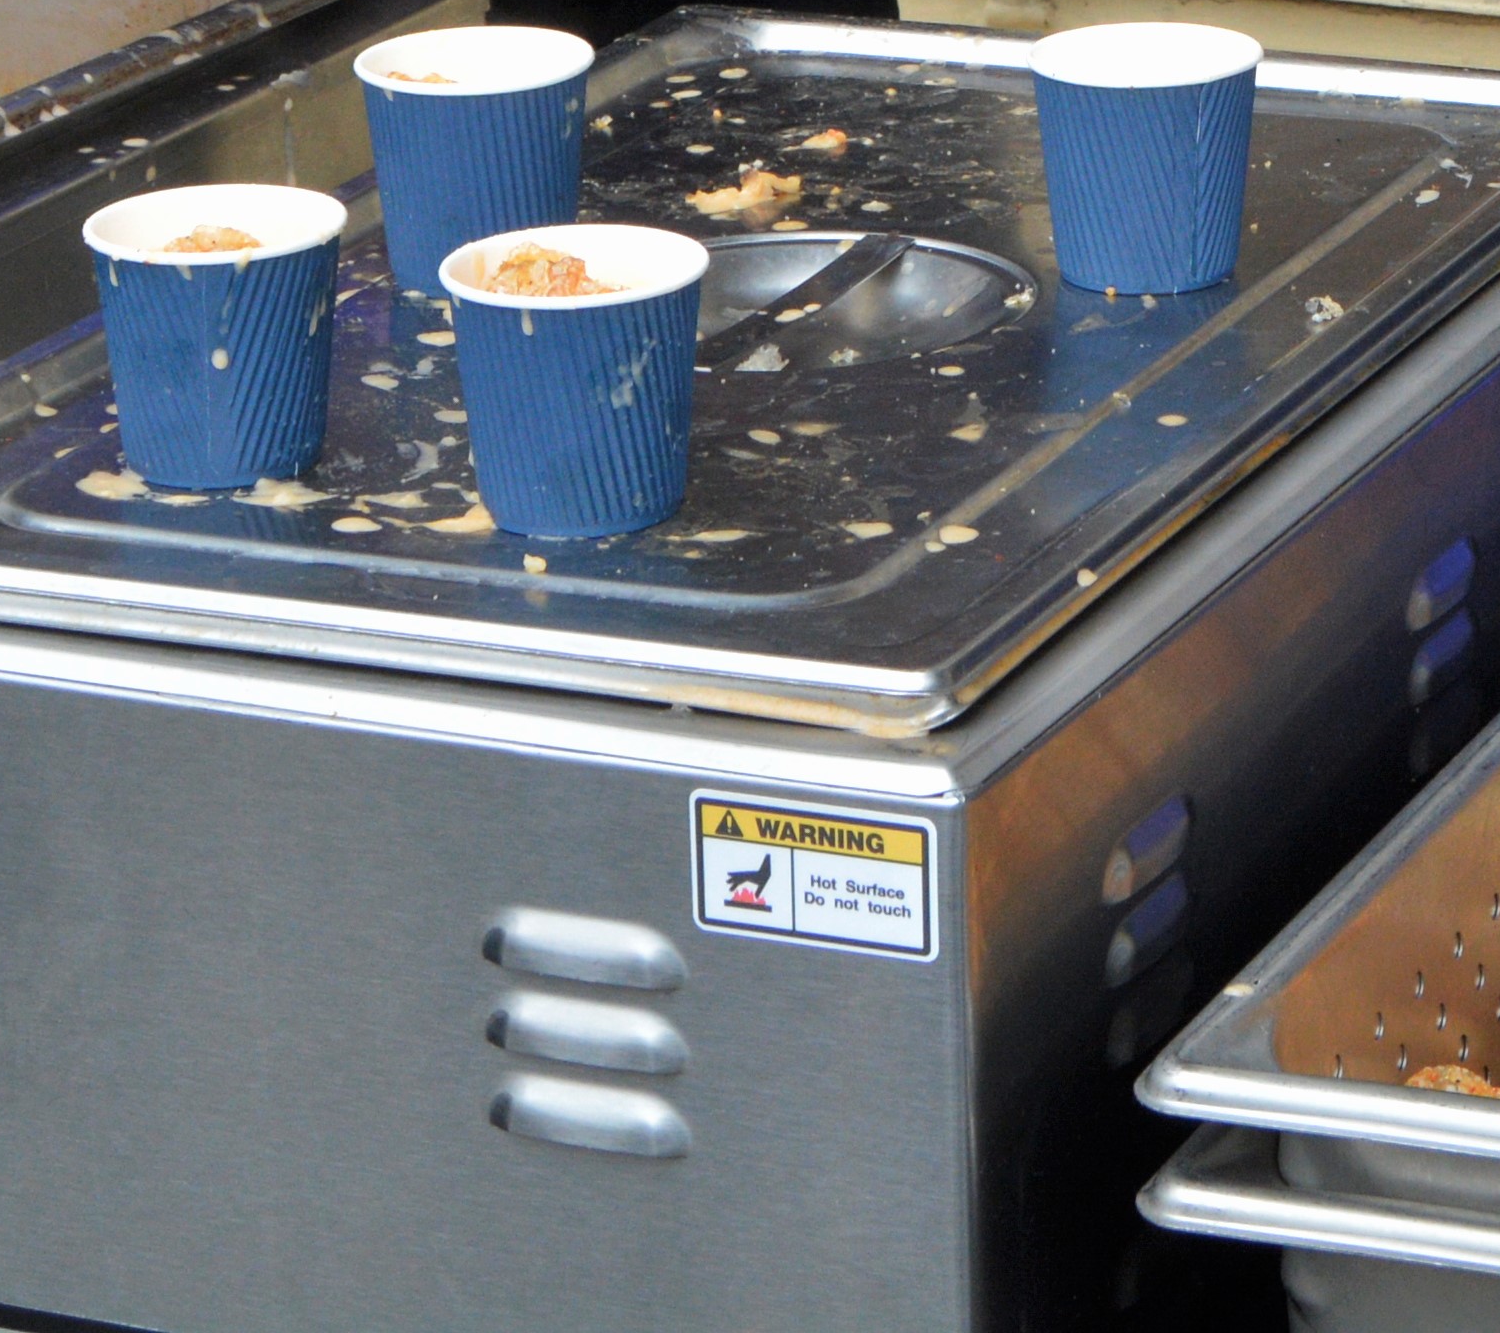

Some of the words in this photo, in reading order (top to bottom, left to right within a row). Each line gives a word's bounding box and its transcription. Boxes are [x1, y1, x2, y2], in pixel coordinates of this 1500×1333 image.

[755, 817, 885, 854] WARNING
[810, 874, 837, 891] Hot
[845, 880, 905, 900] Surface
[804, 891, 825, 906] Do
[834, 897, 859, 912] not
[868, 901, 912, 919] touch
